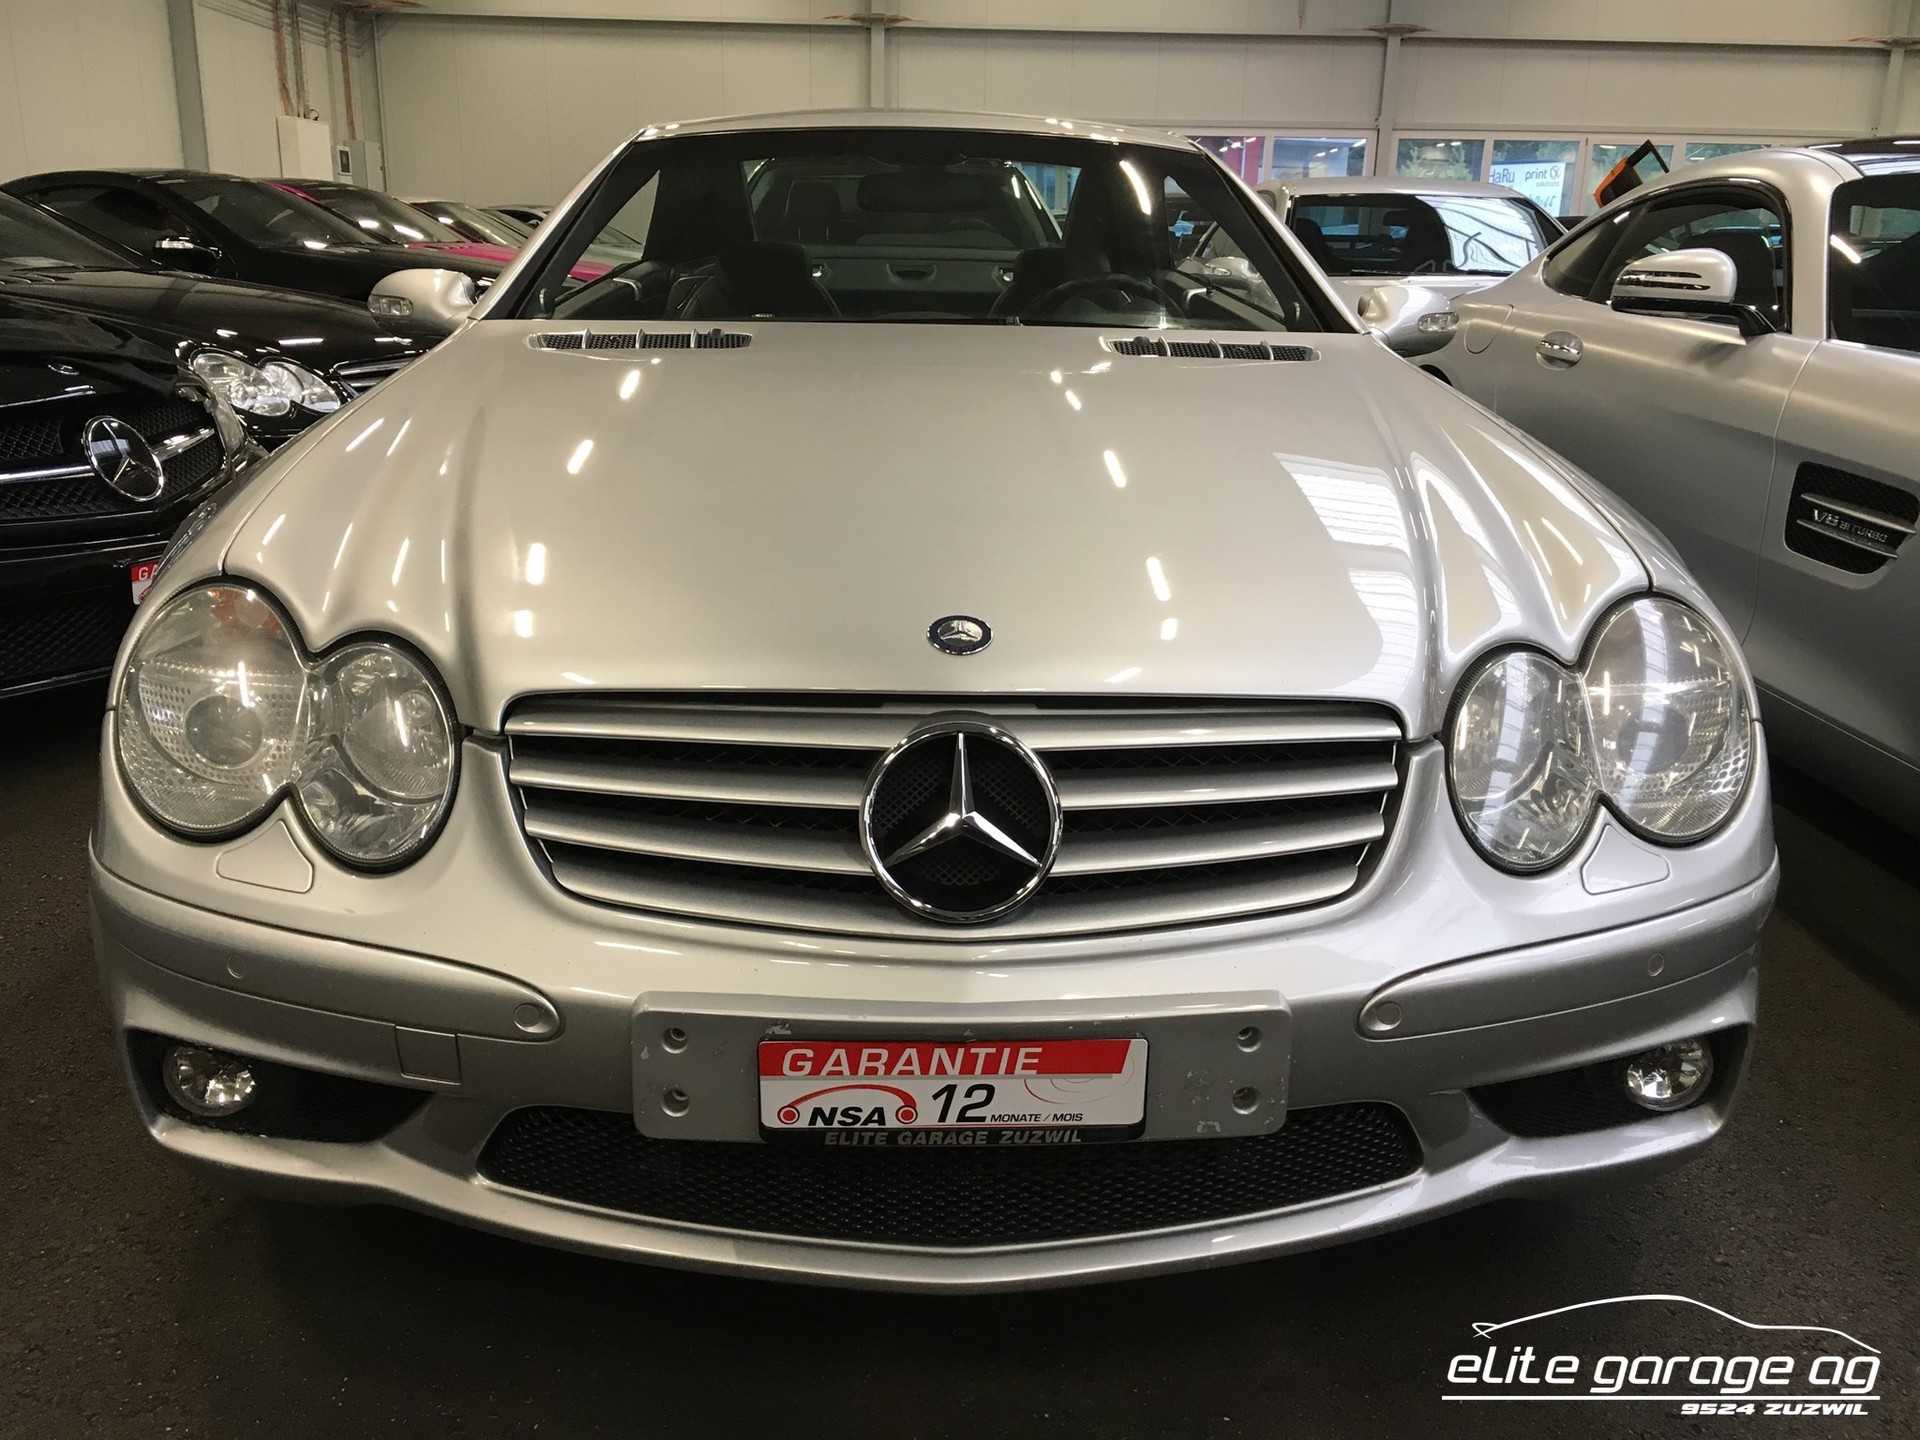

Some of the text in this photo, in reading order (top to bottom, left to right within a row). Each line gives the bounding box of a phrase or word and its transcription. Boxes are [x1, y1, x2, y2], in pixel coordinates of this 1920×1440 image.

[1525, 168, 1548, 182] print
[1814, 509, 1839, 526] V8
[782, 1046, 1043, 1077] GARANTIE
[930, 1083, 996, 1123] 12
[990, 1112, 1042, 1123] MONATE
[1052, 1112, 1084, 1122] MOIS
[807, 1106, 888, 1127] NSA
[824, 1129, 1083, 1146] ELITE GARAGE ZUZWIL
